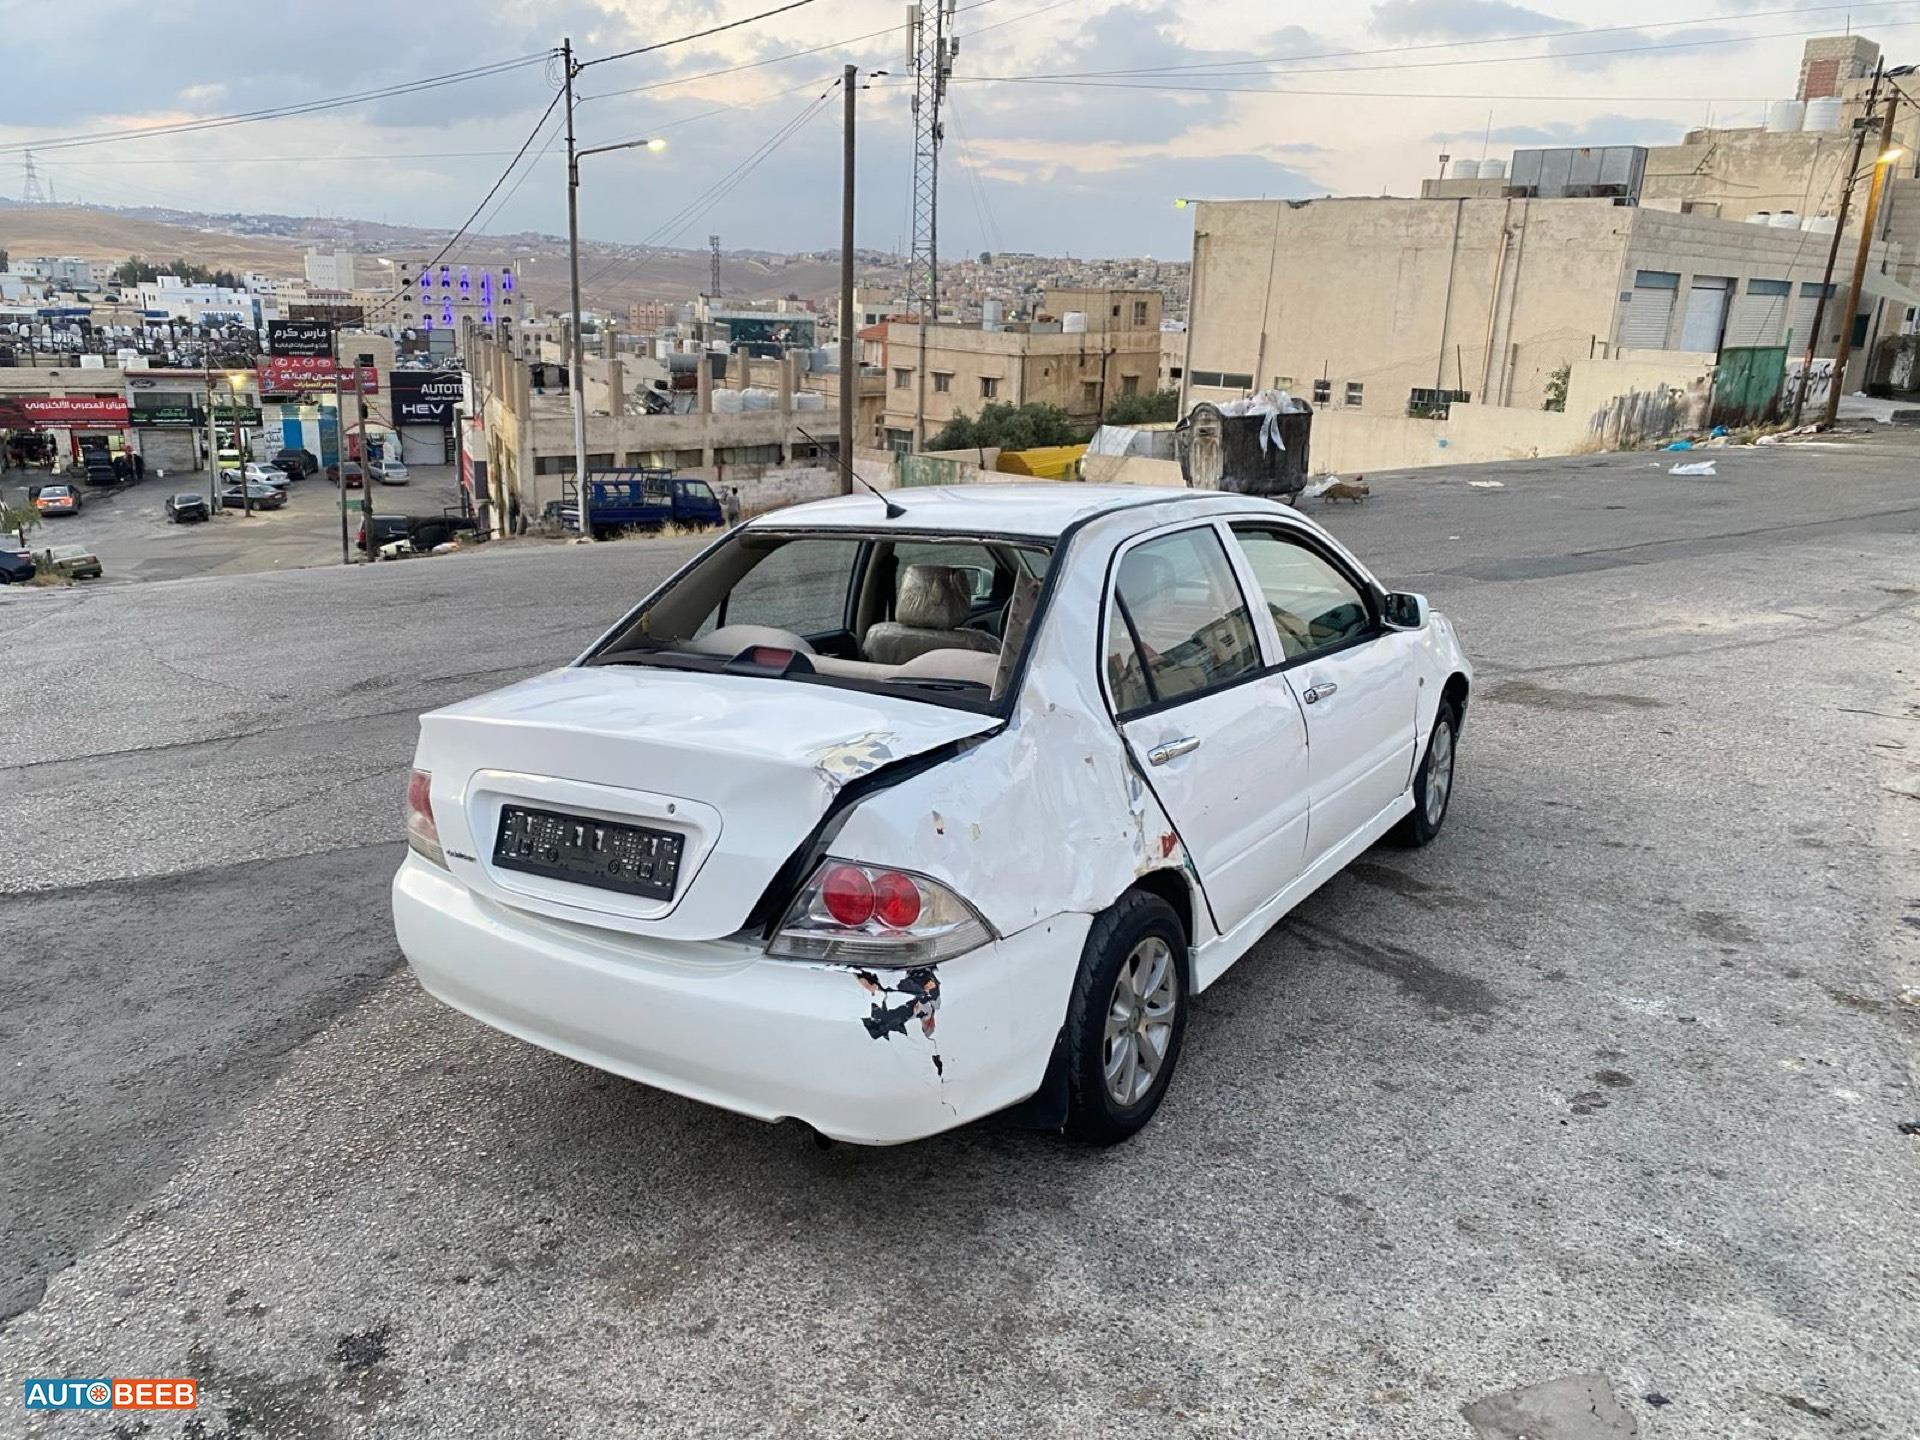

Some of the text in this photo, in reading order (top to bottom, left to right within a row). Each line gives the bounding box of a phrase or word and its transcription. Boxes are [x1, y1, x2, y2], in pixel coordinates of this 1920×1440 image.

[274, 327, 327, 339] فارس كرم
[402, 404, 445, 414] HEV
